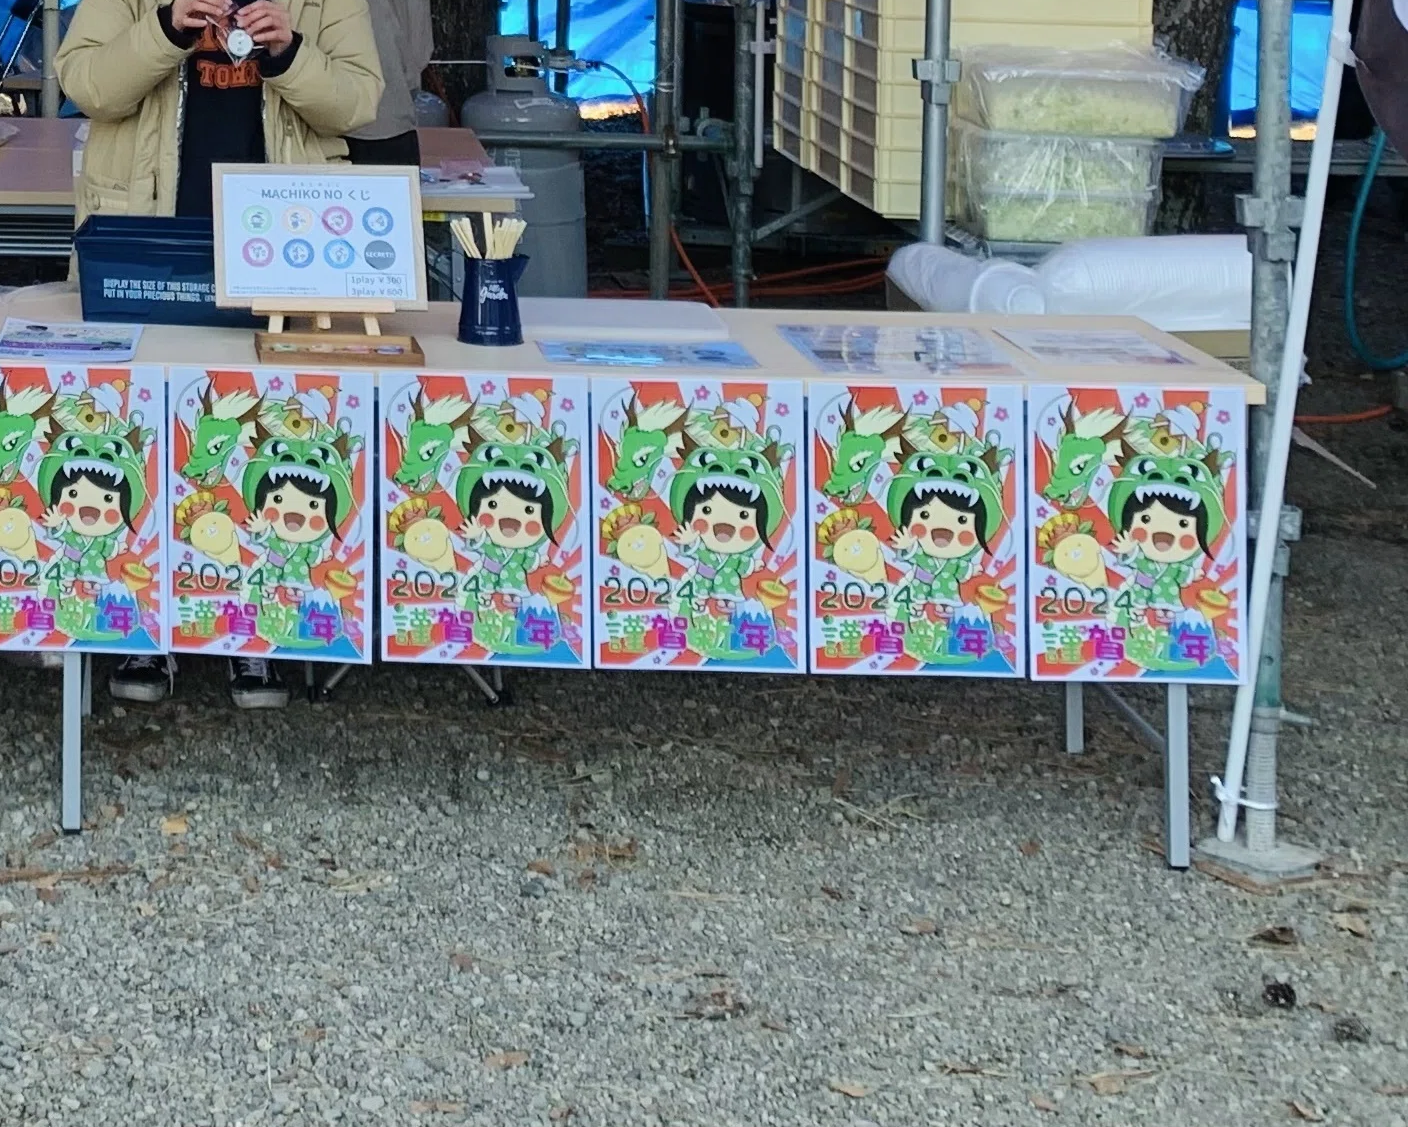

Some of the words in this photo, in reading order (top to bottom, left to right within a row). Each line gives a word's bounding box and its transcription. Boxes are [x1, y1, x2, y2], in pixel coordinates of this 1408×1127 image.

[262, 189, 320, 200] MACHIKO
[324, 190, 343, 200] NO
[348, 189, 371, 201] くじ
[352, 276, 375, 285] 1play
[177, 562, 266, 592] 2024
[391, 570, 482, 600] 2024
[603, 577, 694, 606] 2024
[820, 582, 915, 611] 2024
[1041, 587, 1134, 615] 2024
[178, 594, 338, 647] 謹賀新年
[393, 603, 555, 654] 謹賀新年
[604, 611, 771, 658] 謹賀新年
[822, 614, 989, 661] 謹賀新年
[1042, 620, 1212, 668] 謹賀新年
